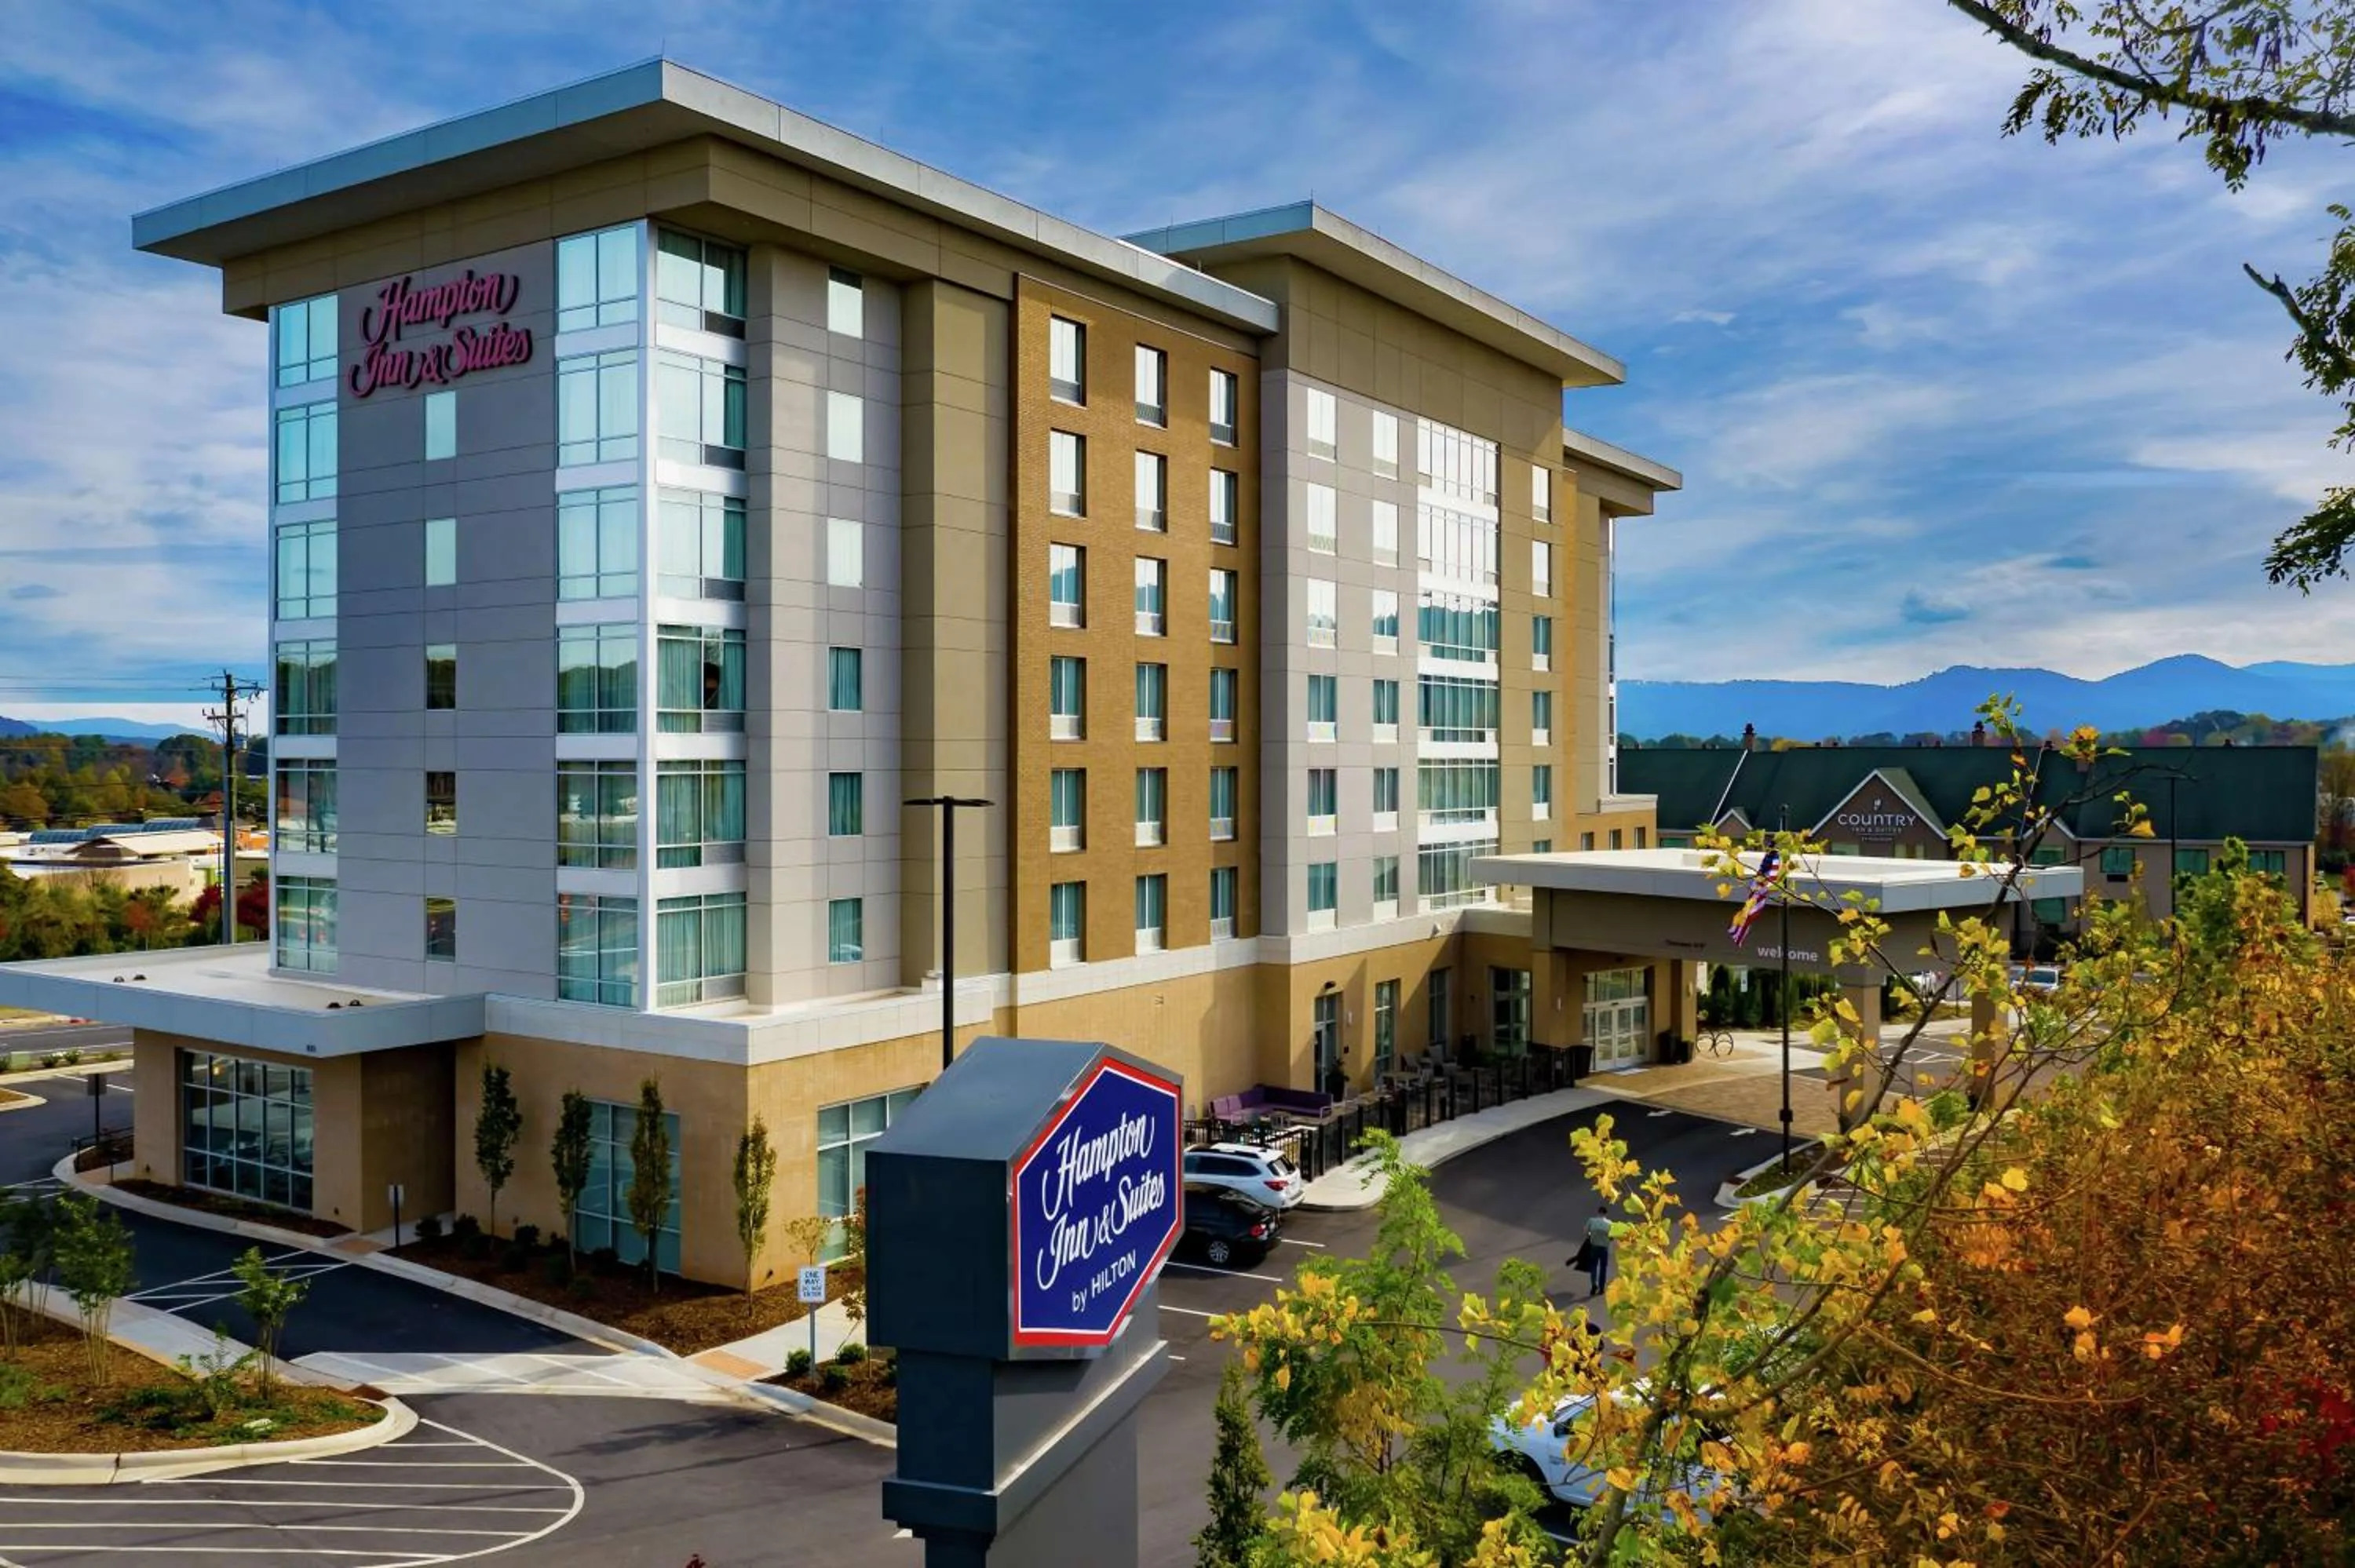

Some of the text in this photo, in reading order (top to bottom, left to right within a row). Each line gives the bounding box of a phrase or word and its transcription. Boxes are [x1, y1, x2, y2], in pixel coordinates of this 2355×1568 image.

[360, 270, 519, 346] Hampton
[346, 323, 533, 398] Inn & Suites
[1838, 814, 1916, 826] COUNTRY
[1758, 946, 1818, 961] welome
[1042, 1111, 1154, 1221] Hampton
[1037, 1169, 1165, 1290] Inn & Suites
[1072, 1249, 1137, 1313] by HILTON
